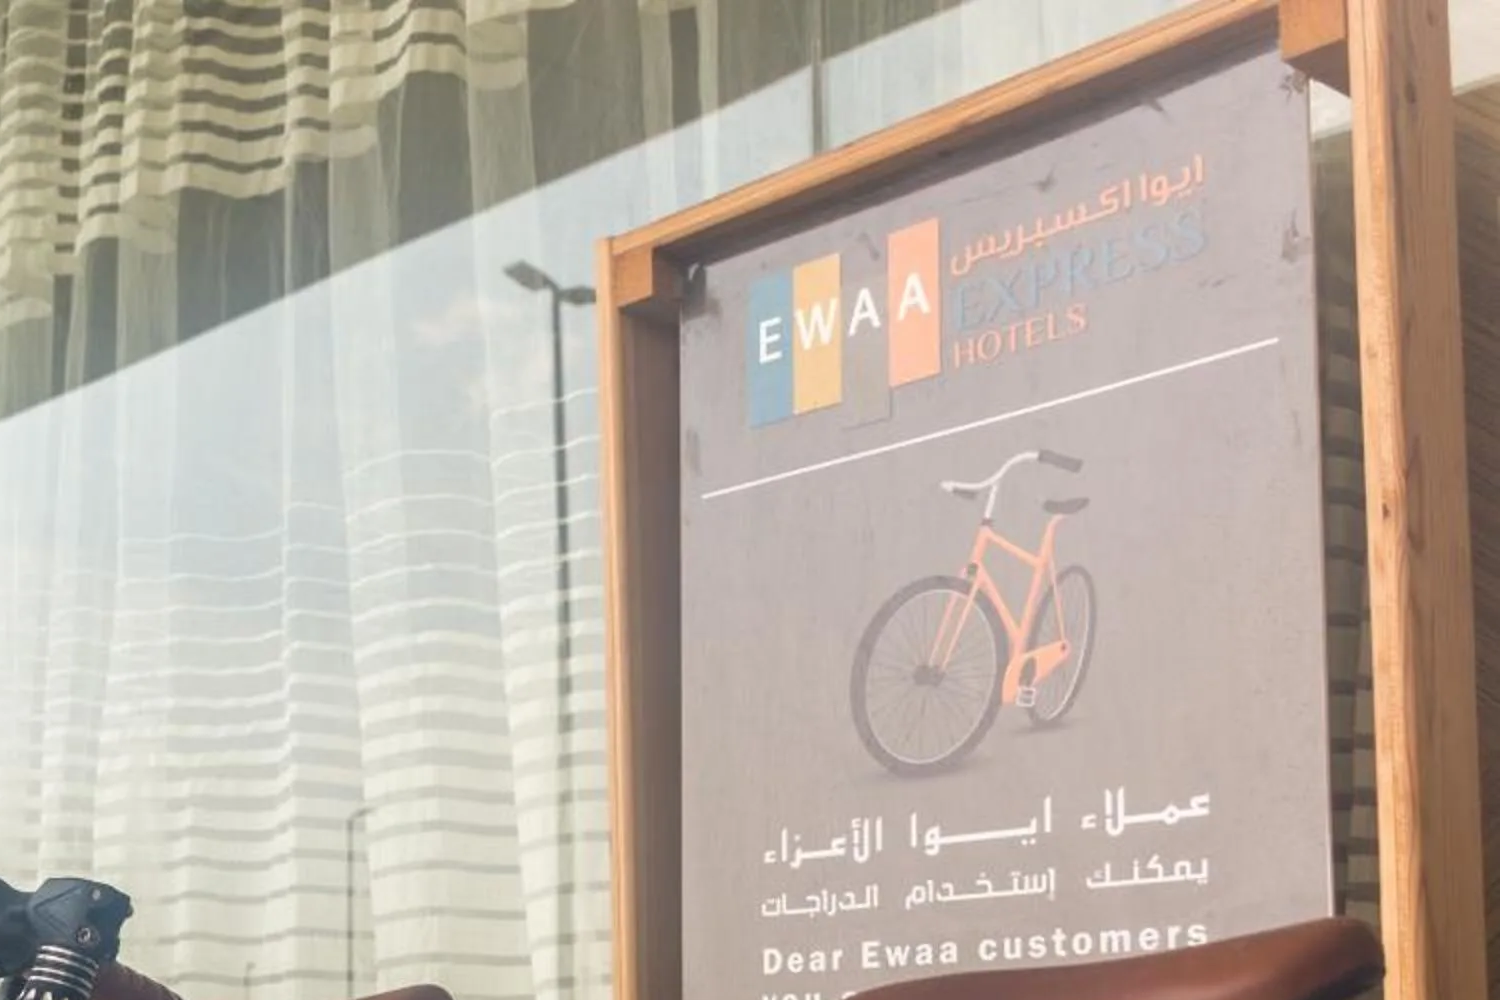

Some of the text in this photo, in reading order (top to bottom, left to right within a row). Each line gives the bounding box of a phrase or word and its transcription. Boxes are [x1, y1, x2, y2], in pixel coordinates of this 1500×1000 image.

[952, 205, 1209, 333] EXPRESS
[758, 272, 931, 364] EWAA
[954, 302, 1088, 369] HOTELS
[762, 923, 1209, 976] Dear Ewaa customers
